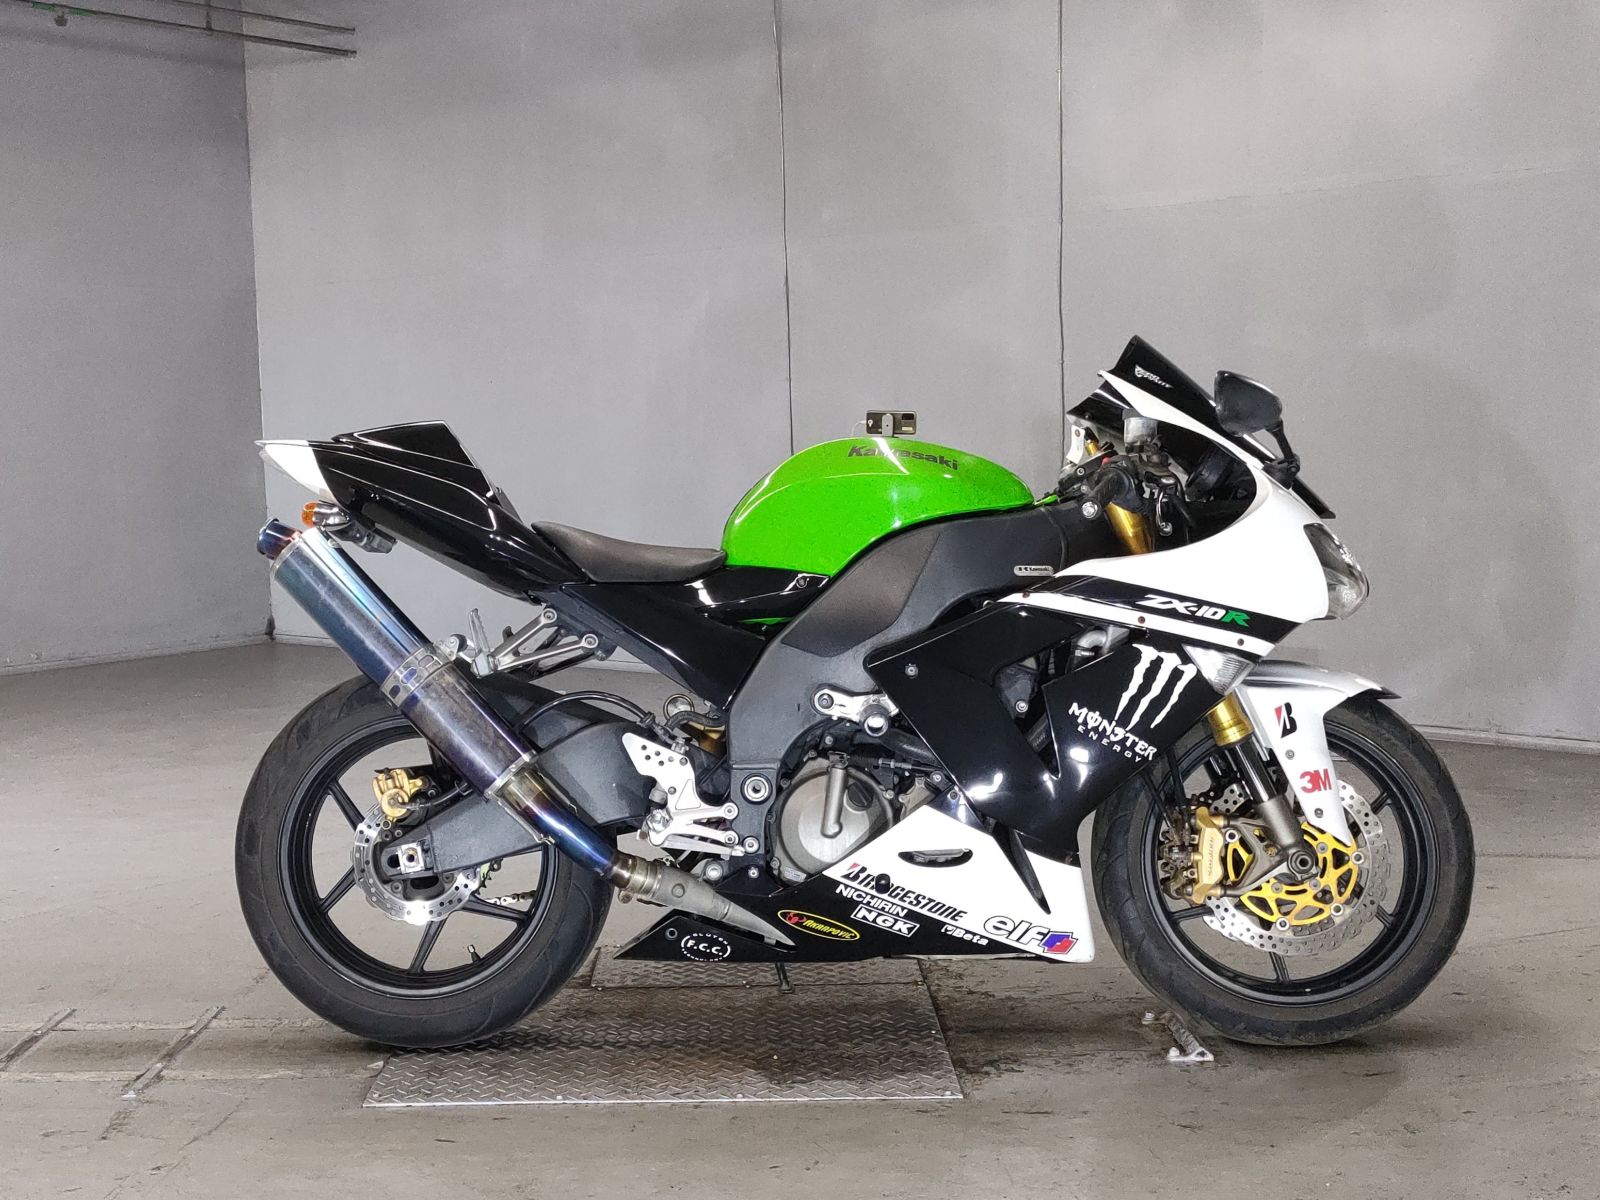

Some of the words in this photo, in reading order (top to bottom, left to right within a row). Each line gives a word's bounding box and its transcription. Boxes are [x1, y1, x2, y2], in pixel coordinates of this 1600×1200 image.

[1135, 594, 1250, 627] ZX-10R
[1068, 702, 1157, 760] MONSTER
[1077, 725, 1141, 762] ENERGY
[1300, 768, 1332, 793] 3M
[835, 883, 908, 917] NICHIRIN
[840, 862, 968, 921] BRGESTONE
[855, 907, 914, 935] NGK
[983, 915, 1050, 946] elf
